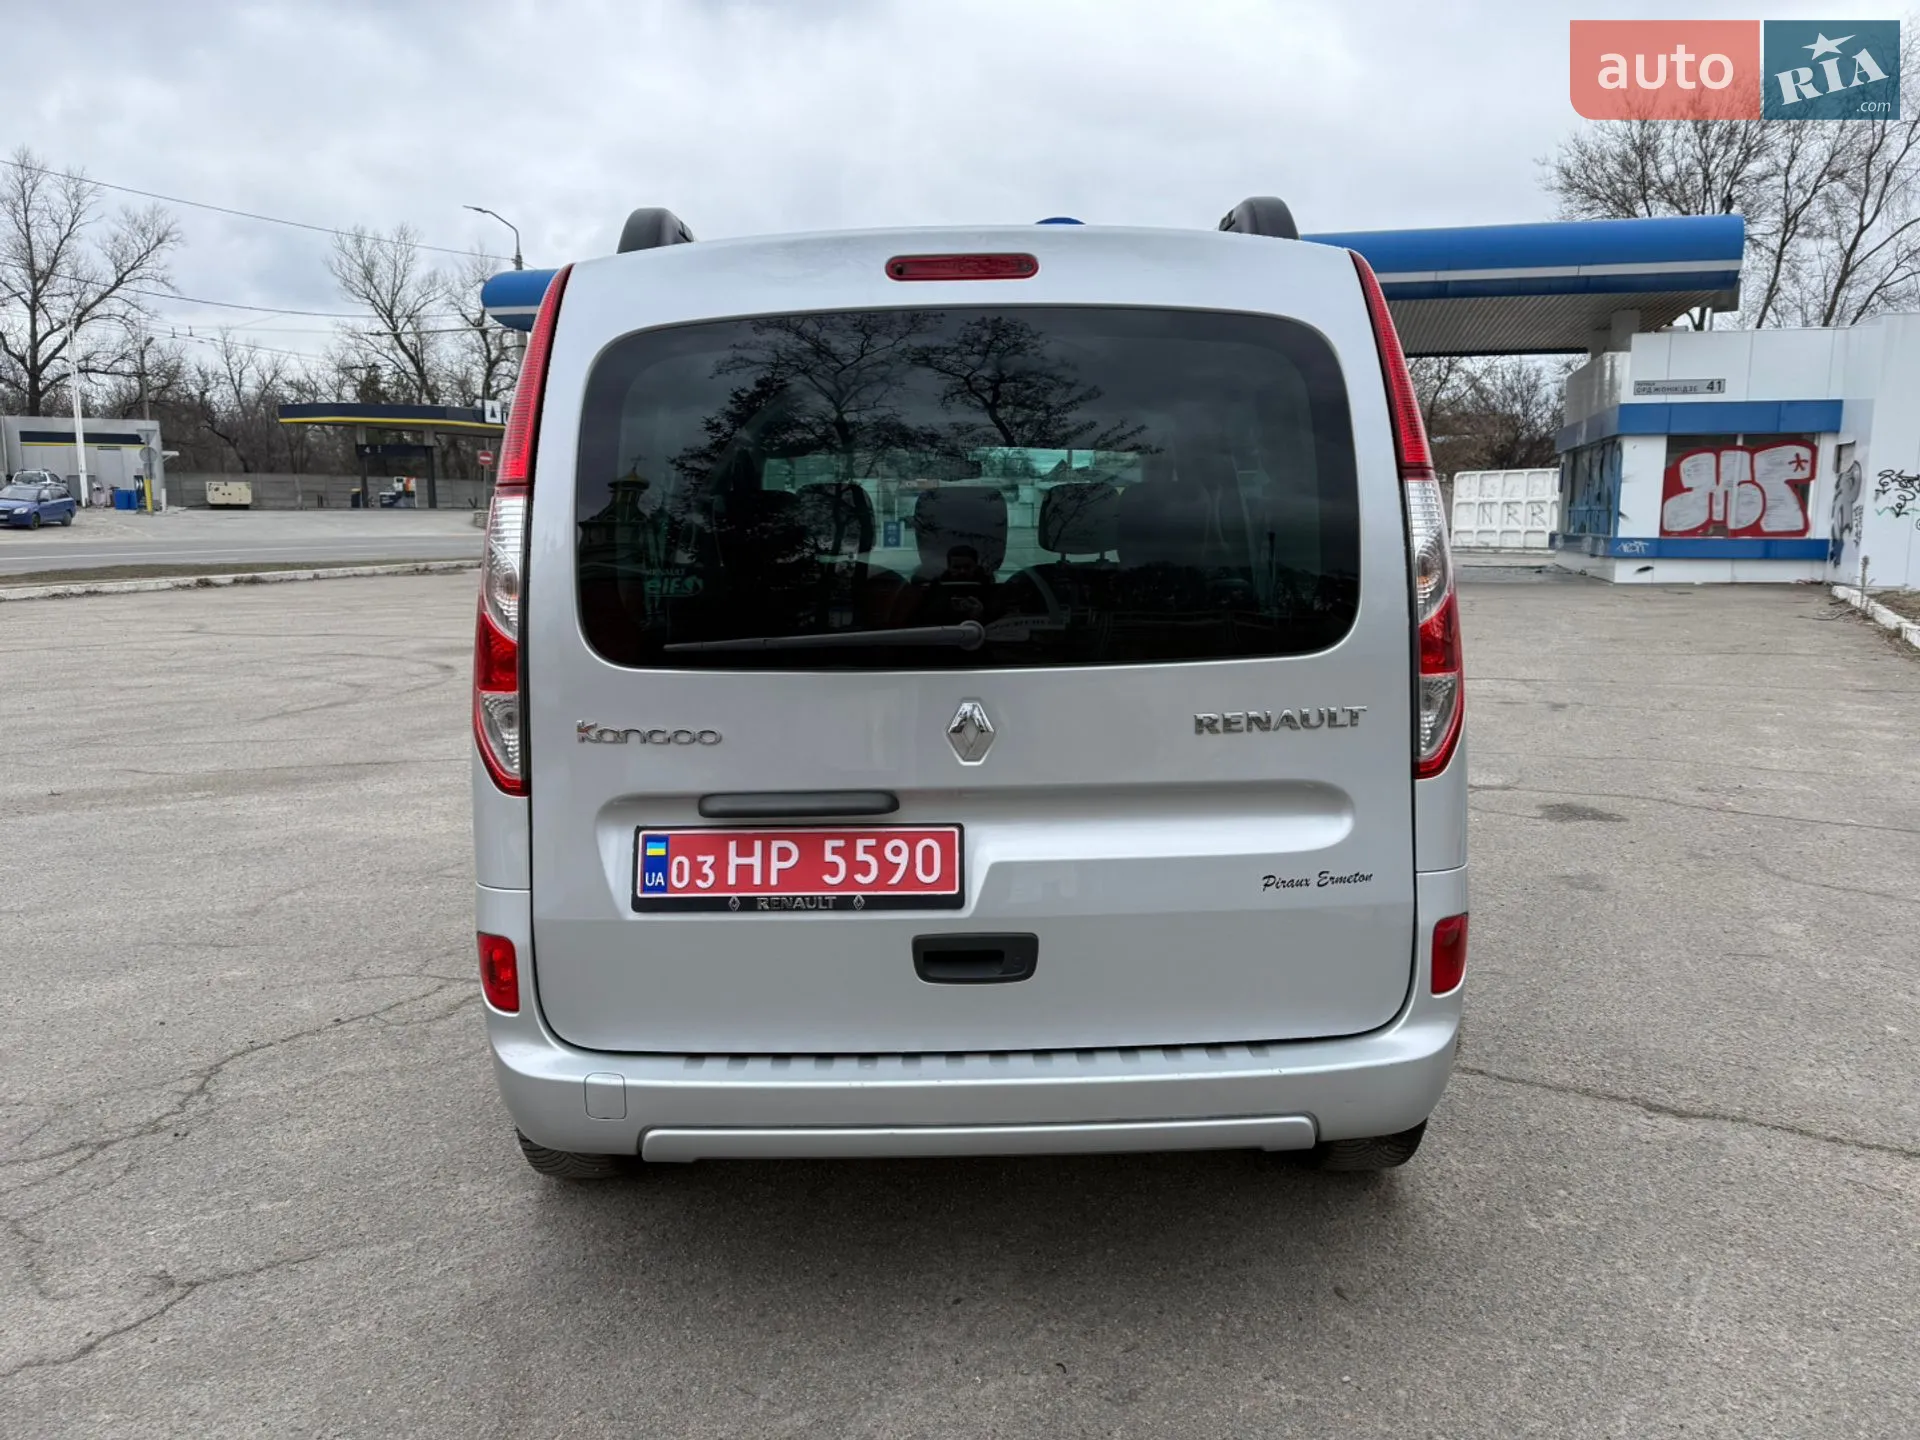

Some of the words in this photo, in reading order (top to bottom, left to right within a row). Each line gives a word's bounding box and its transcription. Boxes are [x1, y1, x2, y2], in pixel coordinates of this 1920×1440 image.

[1706, 380, 1722, 392] 41
[1194, 705, 1368, 735] RENAULT
[576, 719, 723, 745] Kangoo
[671, 855, 716, 889] 03
[728, 839, 800, 886] HP
[822, 838, 942, 885] 5590
[645, 872, 665, 887] UA
[1262, 874, 1311, 892] Piraux
[756, 896, 837, 910] RENAULT
